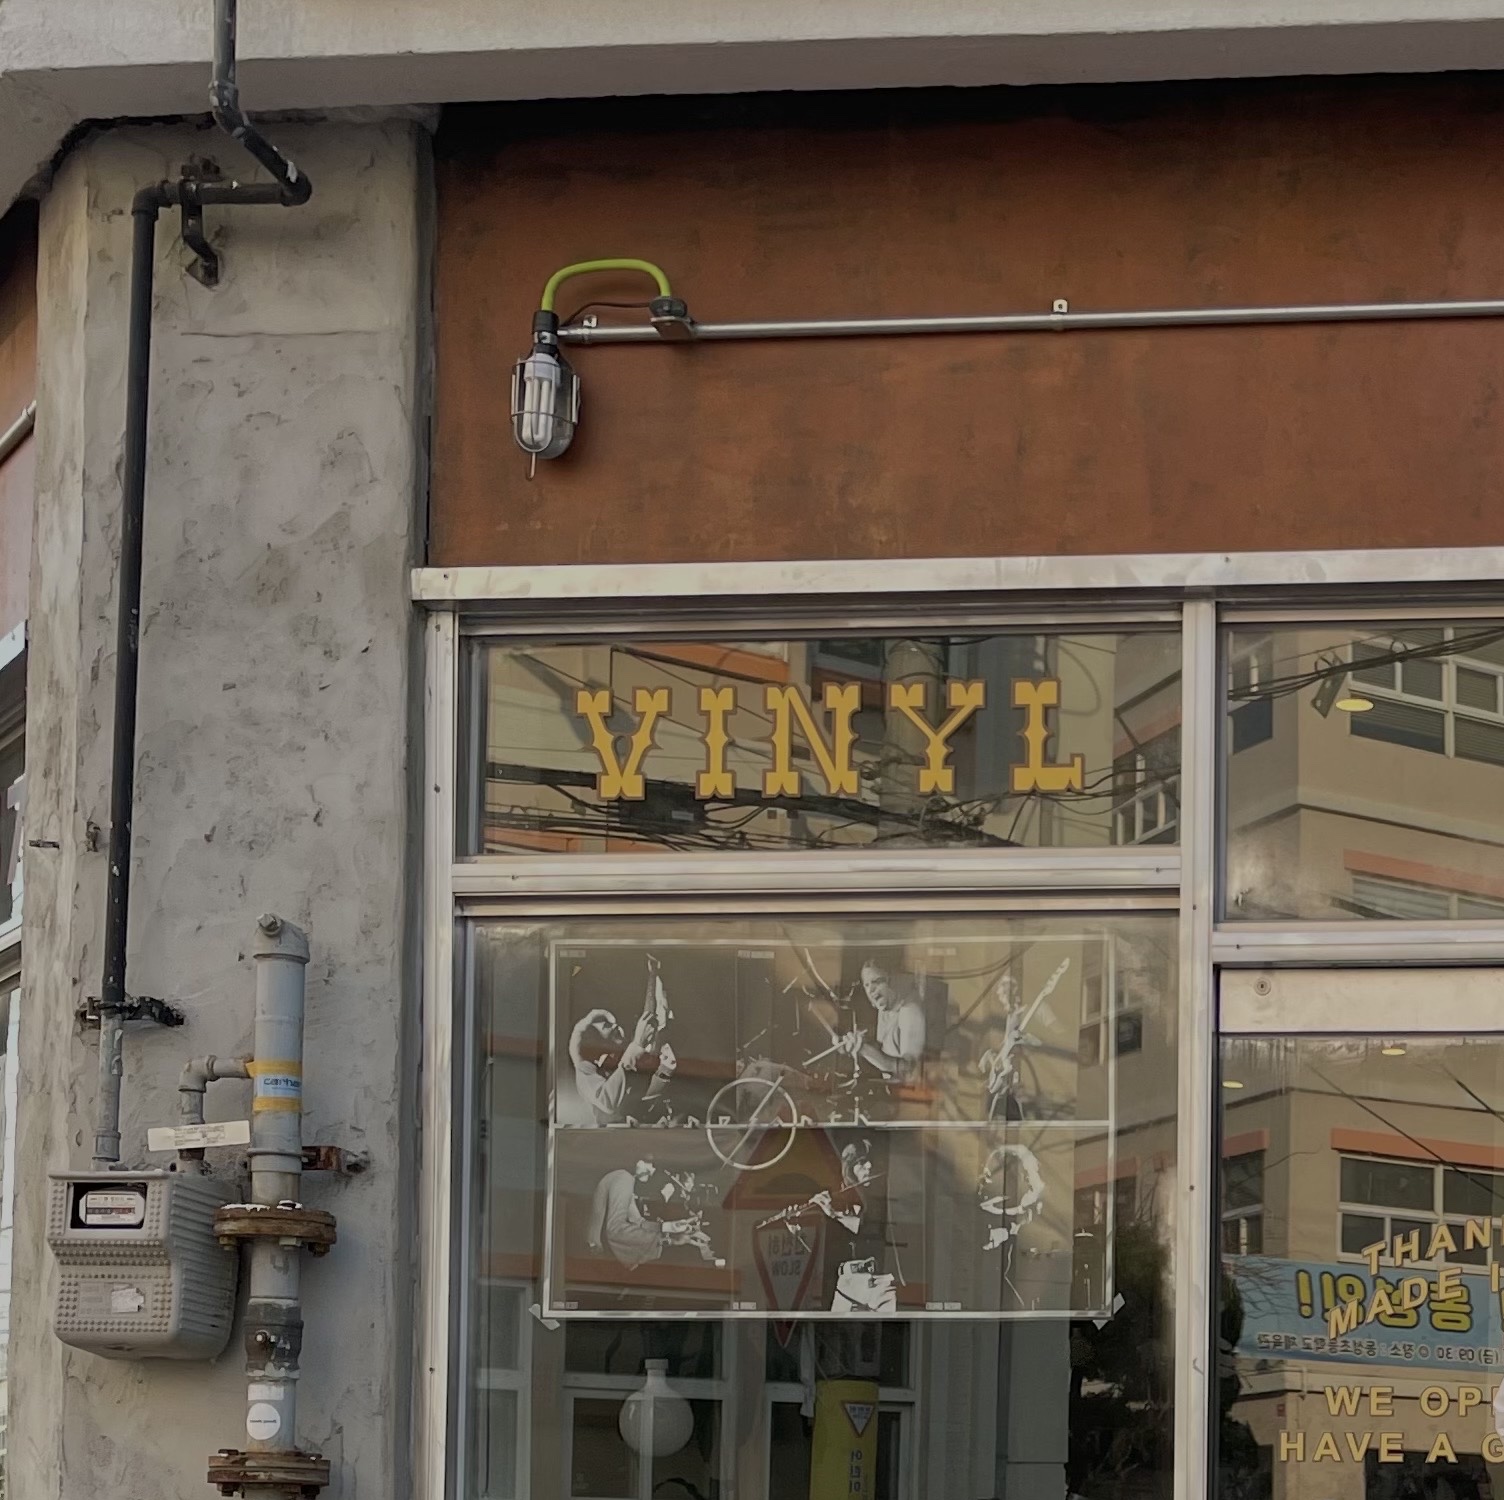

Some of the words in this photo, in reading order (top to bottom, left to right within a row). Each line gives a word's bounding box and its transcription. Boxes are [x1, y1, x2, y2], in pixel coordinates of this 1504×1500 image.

[576, 678, 1084, 801] VINYL
[1327, 1267, 1463, 1339] MADE
[1324, 1386, 1394, 1417] WE
[1420, 1386, 1498, 1417] OP
[1279, 1430, 1404, 1463] HAVE
[1425, 1432, 1458, 1463] A
